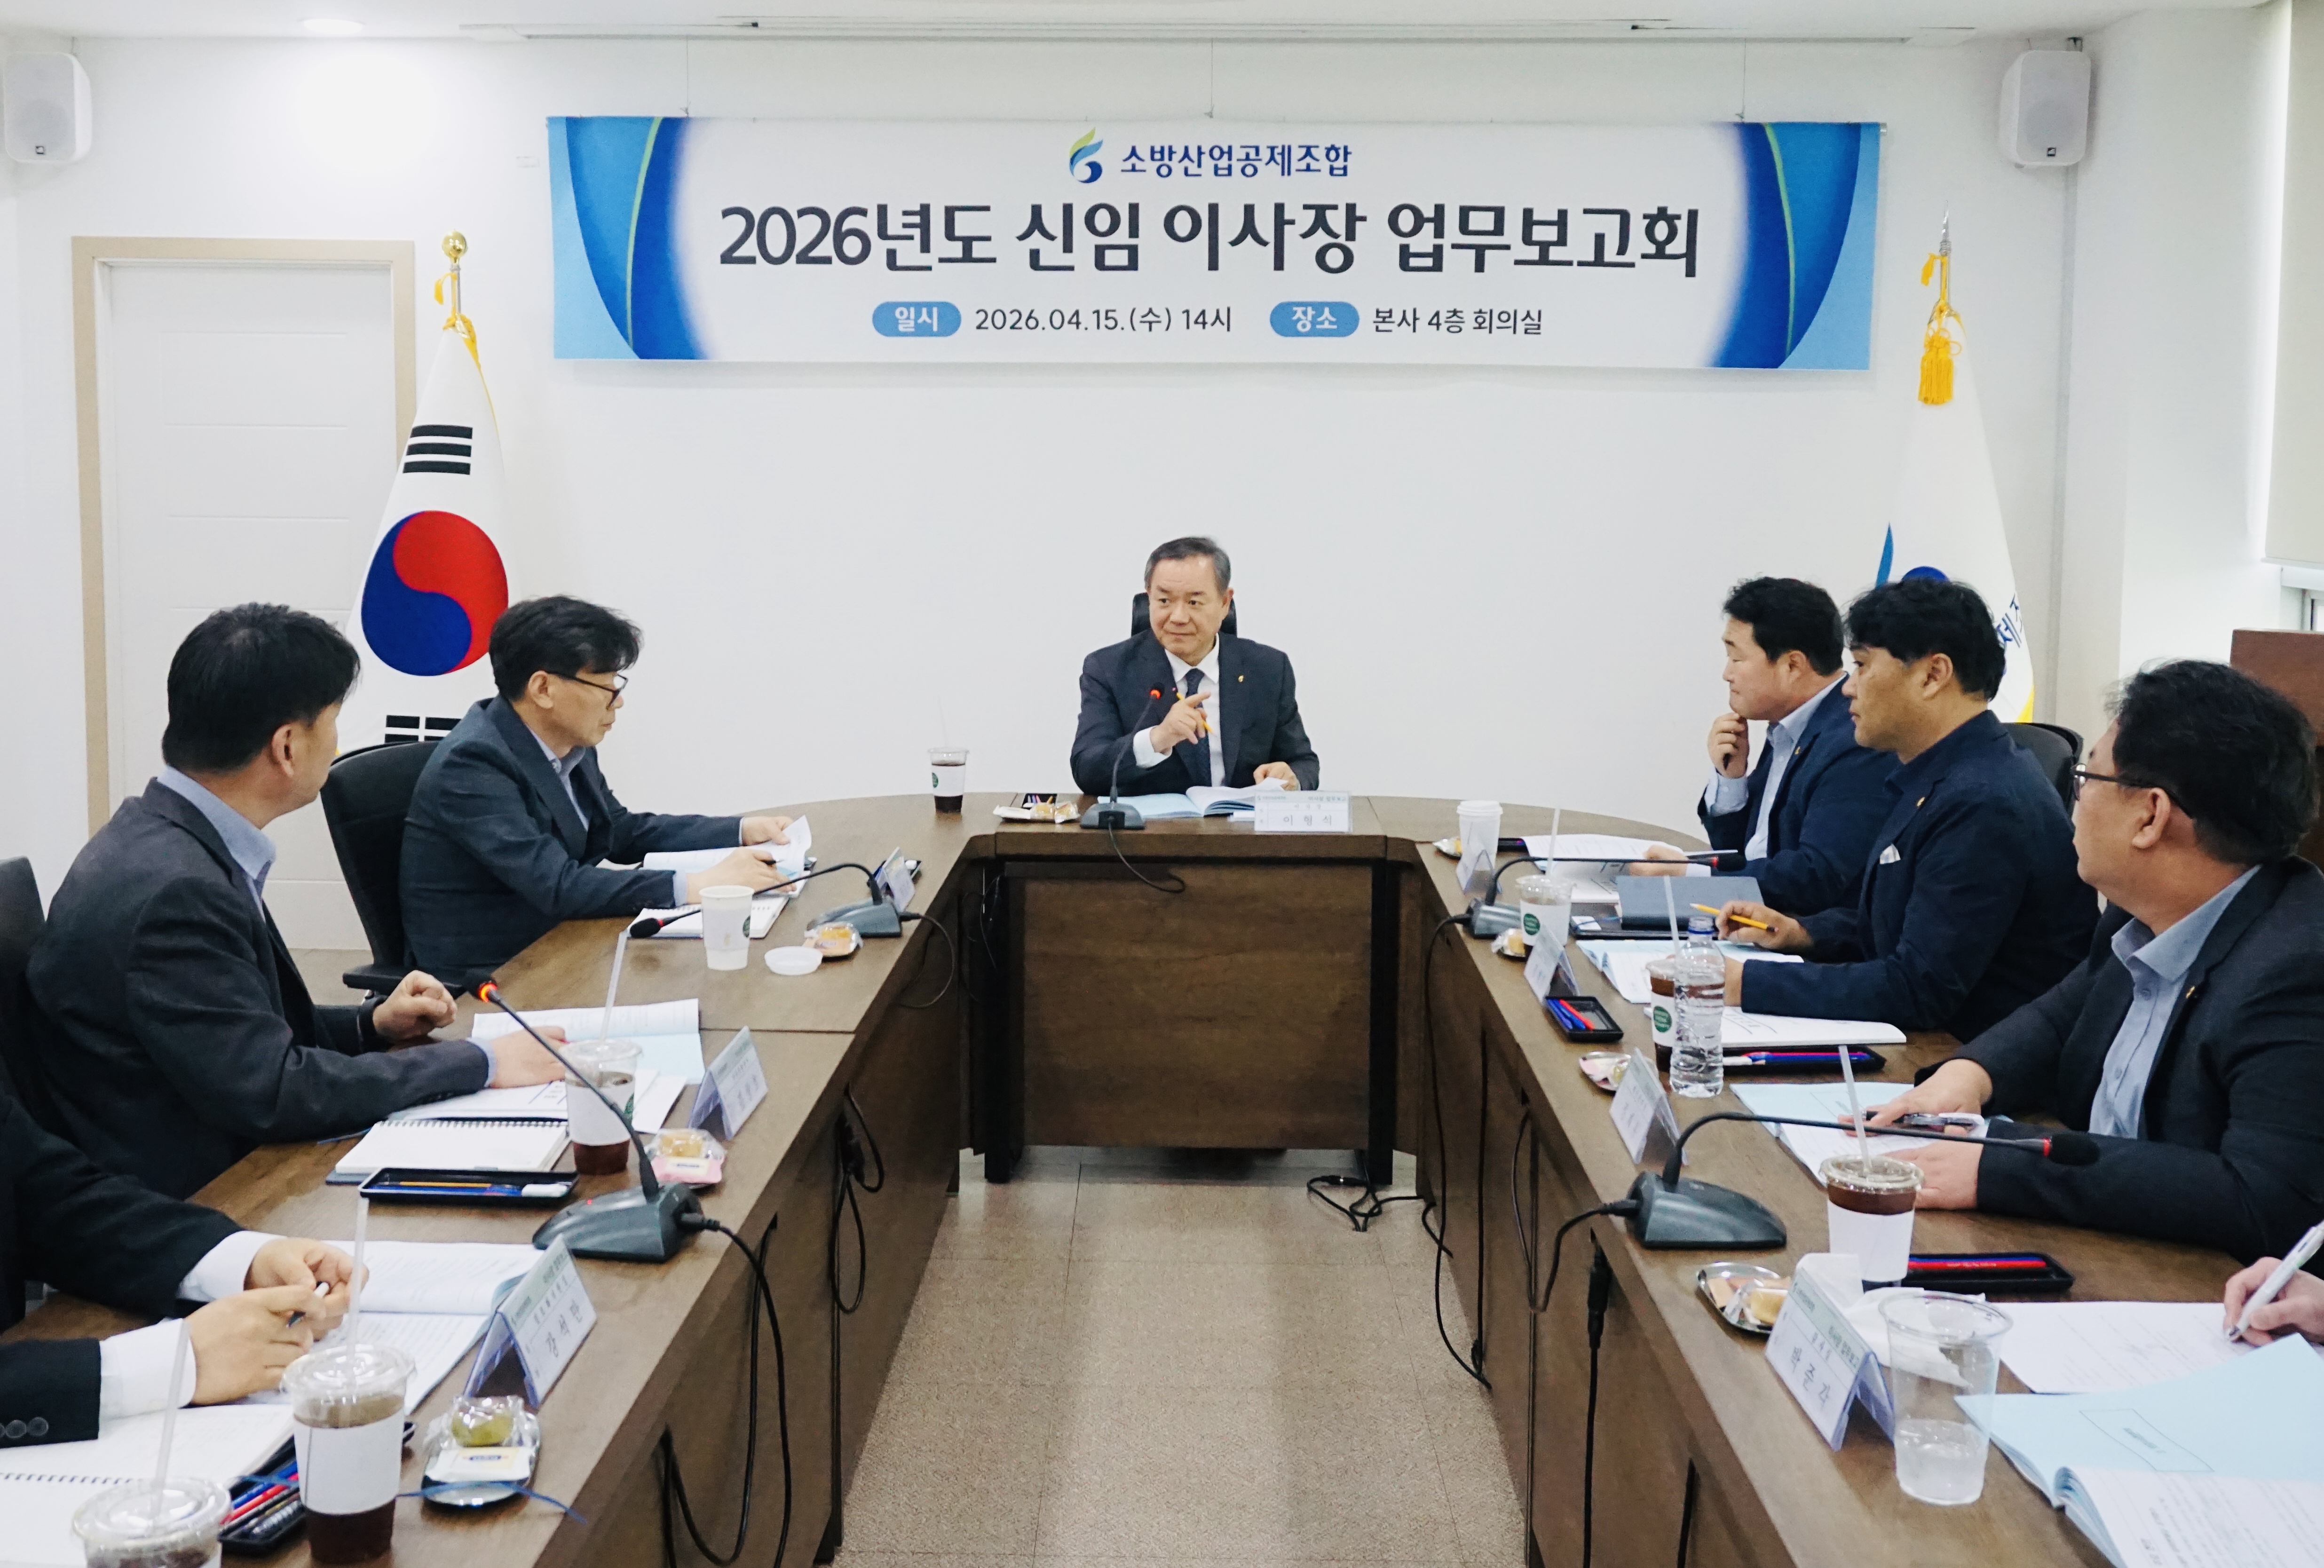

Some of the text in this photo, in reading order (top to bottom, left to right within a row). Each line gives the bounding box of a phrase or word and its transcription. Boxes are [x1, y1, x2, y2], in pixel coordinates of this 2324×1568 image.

[1120, 143, 1352, 179] 소방산업공제조합
[720, 202, 1699, 278] 2026년도 신임 이사장 업무보고회
[894, 306, 938, 332] 일시
[975, 306, 1231, 332] 2026.04.15.(수) 14시
[1291, 306, 1338, 333] 장소
[1372, 307, 1542, 335] 본사 4층 회의실
